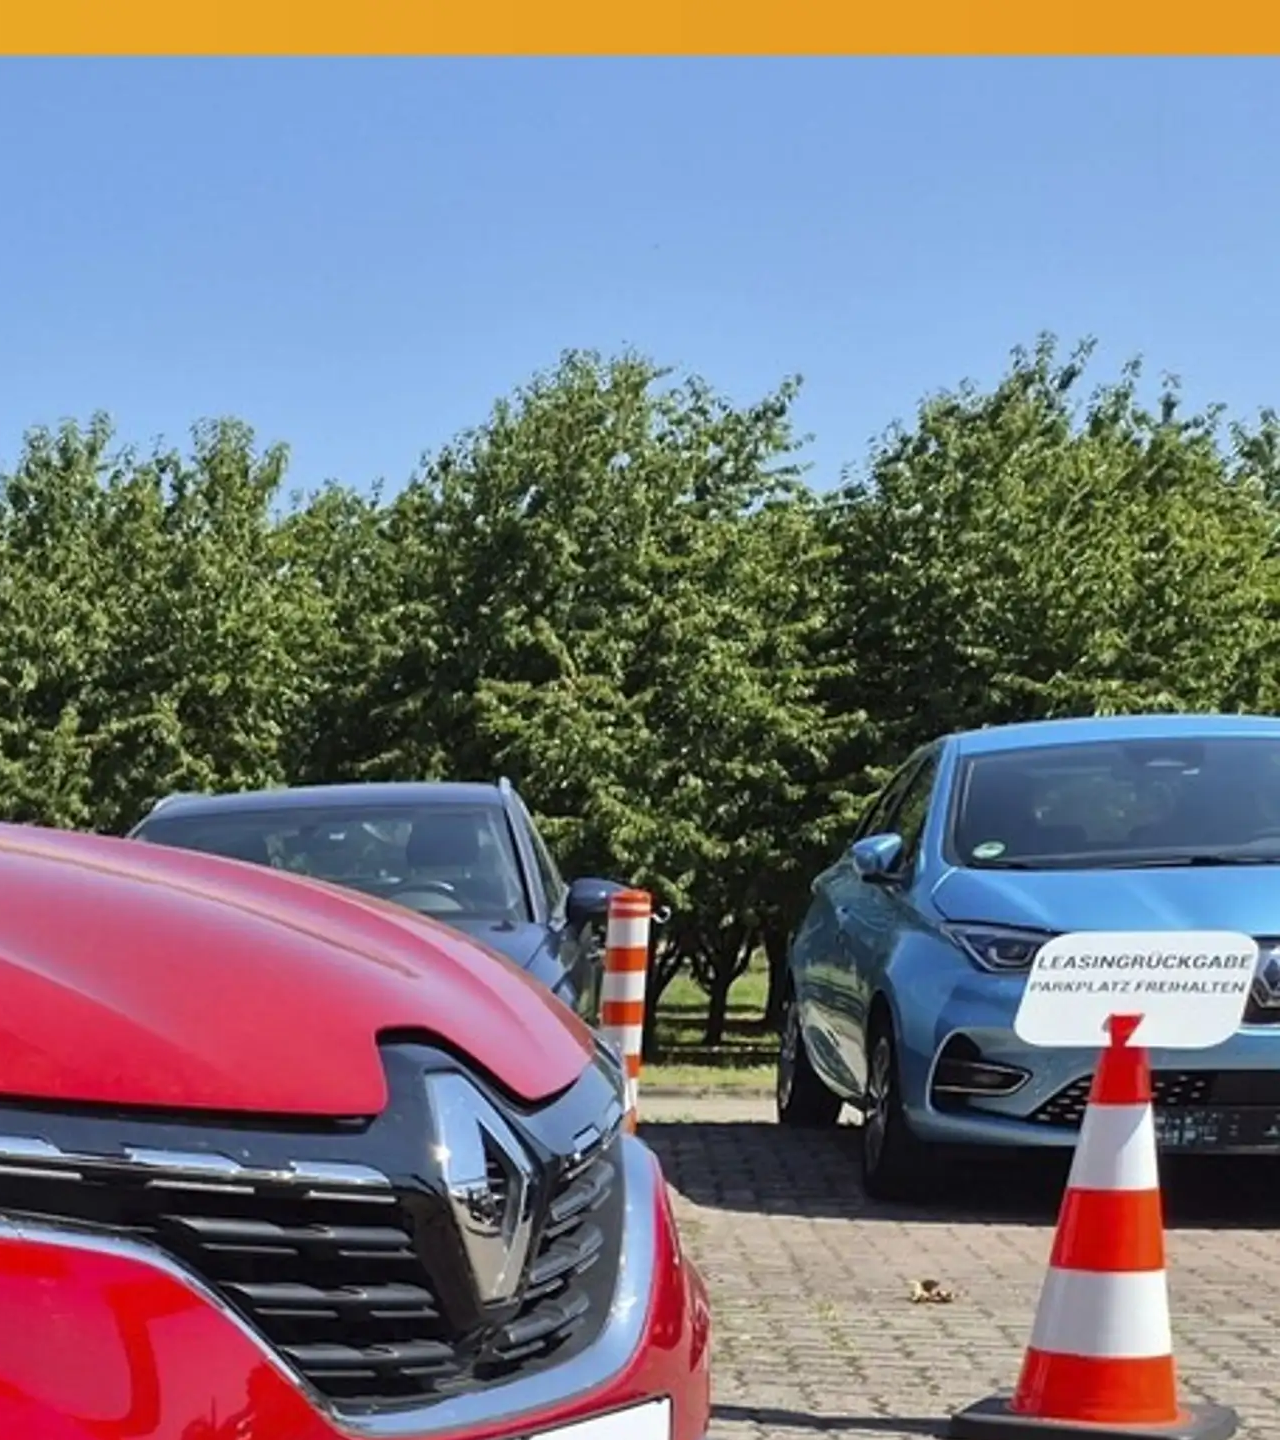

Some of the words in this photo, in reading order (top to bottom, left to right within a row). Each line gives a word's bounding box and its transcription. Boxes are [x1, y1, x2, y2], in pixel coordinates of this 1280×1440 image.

[1038, 952, 1253, 970] LEASINGRÜCKGABE
[1030, 980, 1131, 993] PARKPLATZ
[1133, 980, 1246, 993] FREIHALTEN
